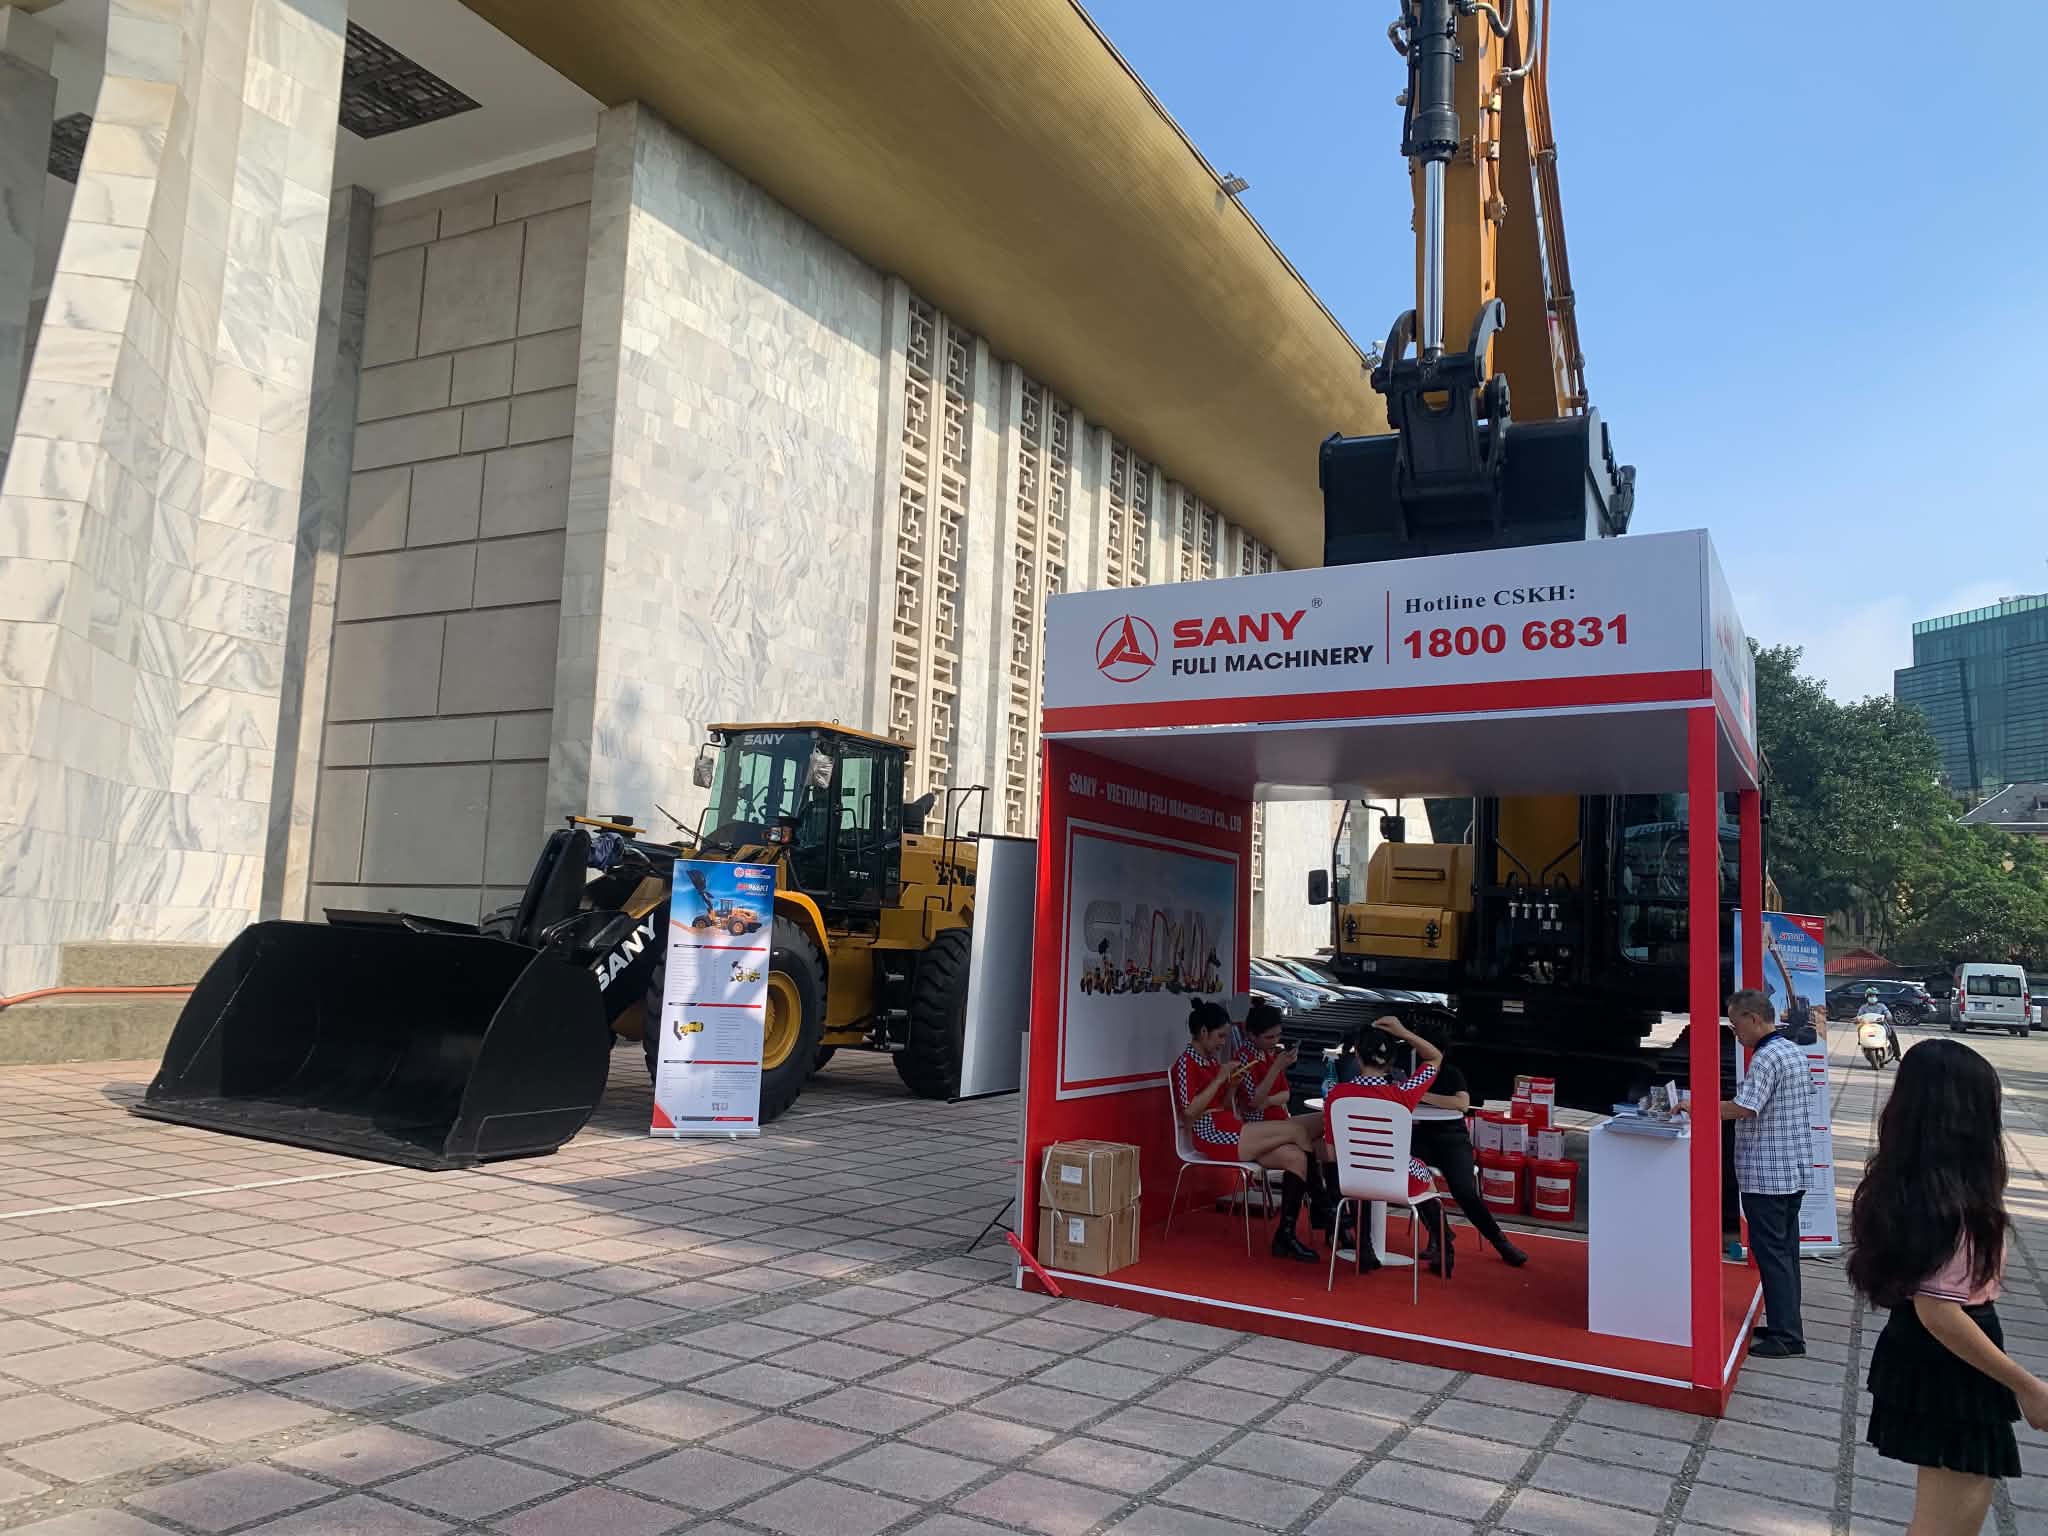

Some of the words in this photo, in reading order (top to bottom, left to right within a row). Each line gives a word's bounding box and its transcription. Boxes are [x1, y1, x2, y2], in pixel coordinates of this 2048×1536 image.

[1405, 595, 1487, 614] Hotline
[1494, 585, 1576, 605] CSKH:
[1173, 609, 1306, 648] SANY
[1404, 624, 1506, 659] 1800
[1522, 613, 1628, 651] 6831
[1171, 656, 1217, 676] FULI
[1225, 645, 1374, 673] MACHINERY
[743, 733, 785, 746] SANY
[1069, 772, 1097, 797] SANY
[595, 912, 656, 992] SANY
